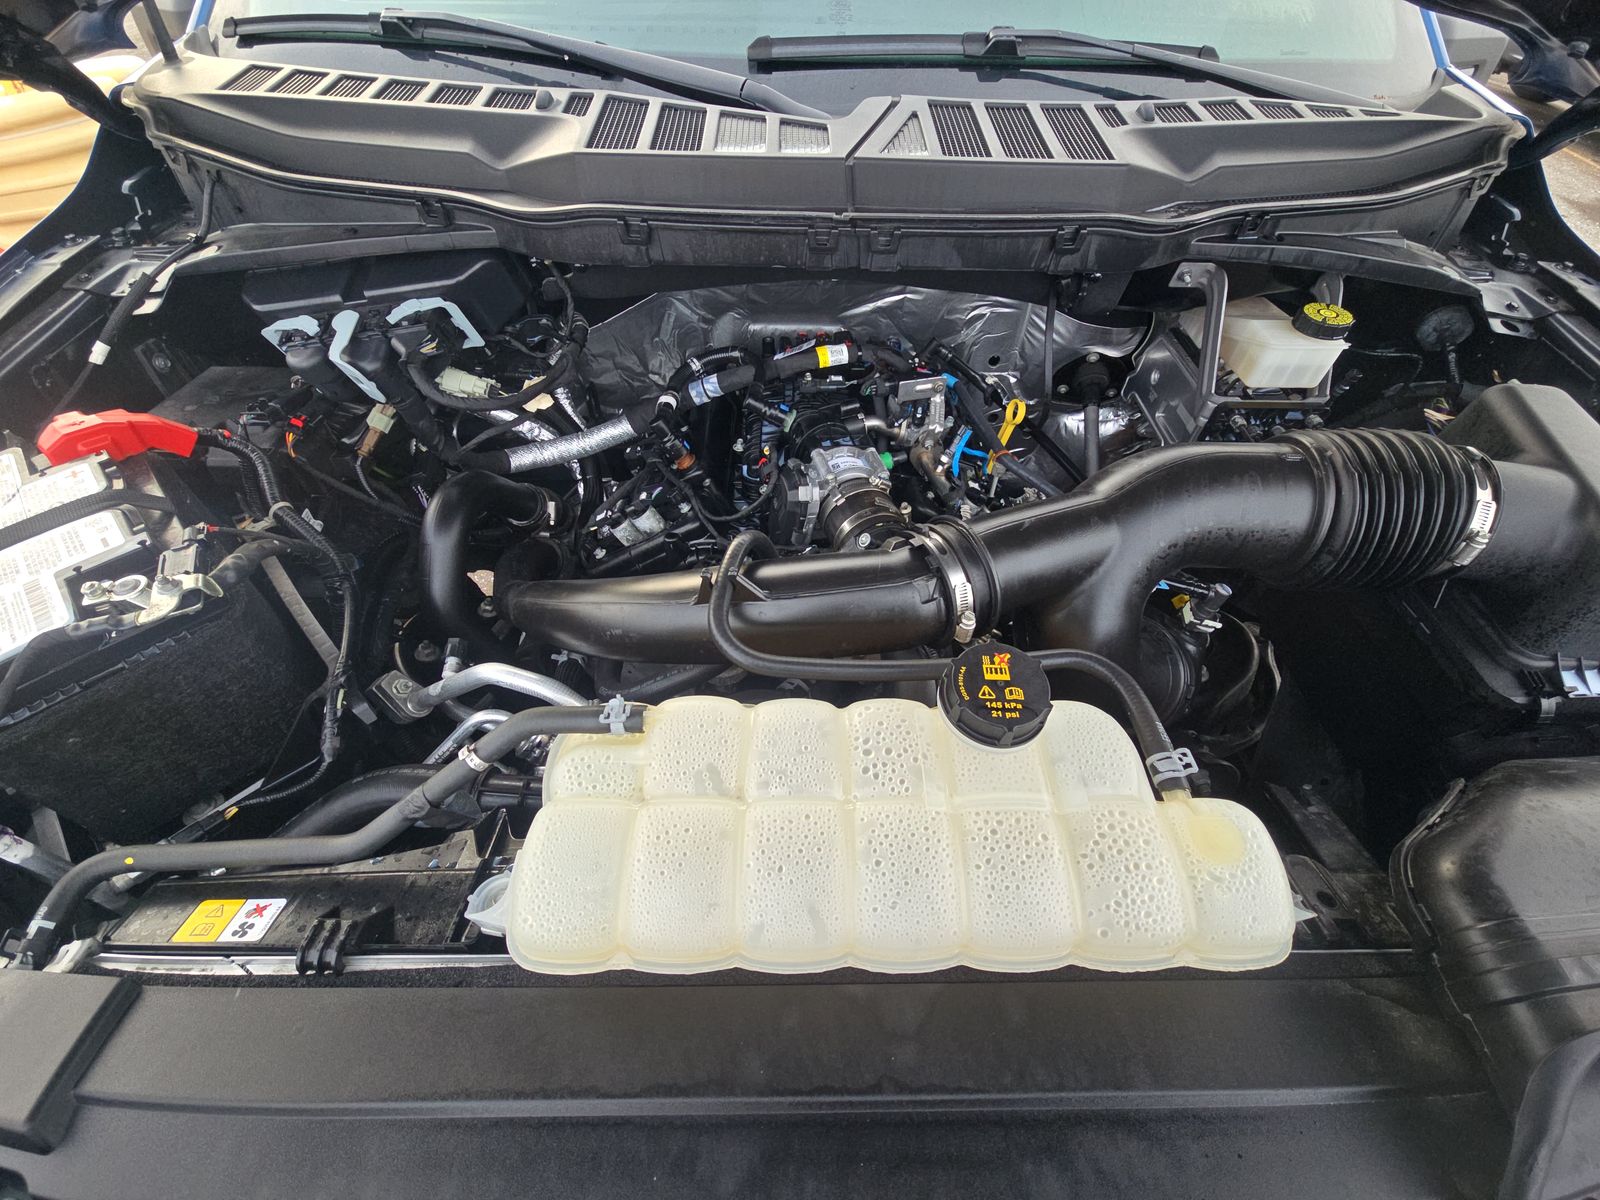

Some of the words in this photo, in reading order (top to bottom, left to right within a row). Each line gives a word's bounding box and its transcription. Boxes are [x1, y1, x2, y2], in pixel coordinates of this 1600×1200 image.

[985, 701, 1003, 709] 145
[1004, 701, 1023, 709] kPa
[991, 710, 1003, 718] 21
[1005, 711, 1020, 719] psi
